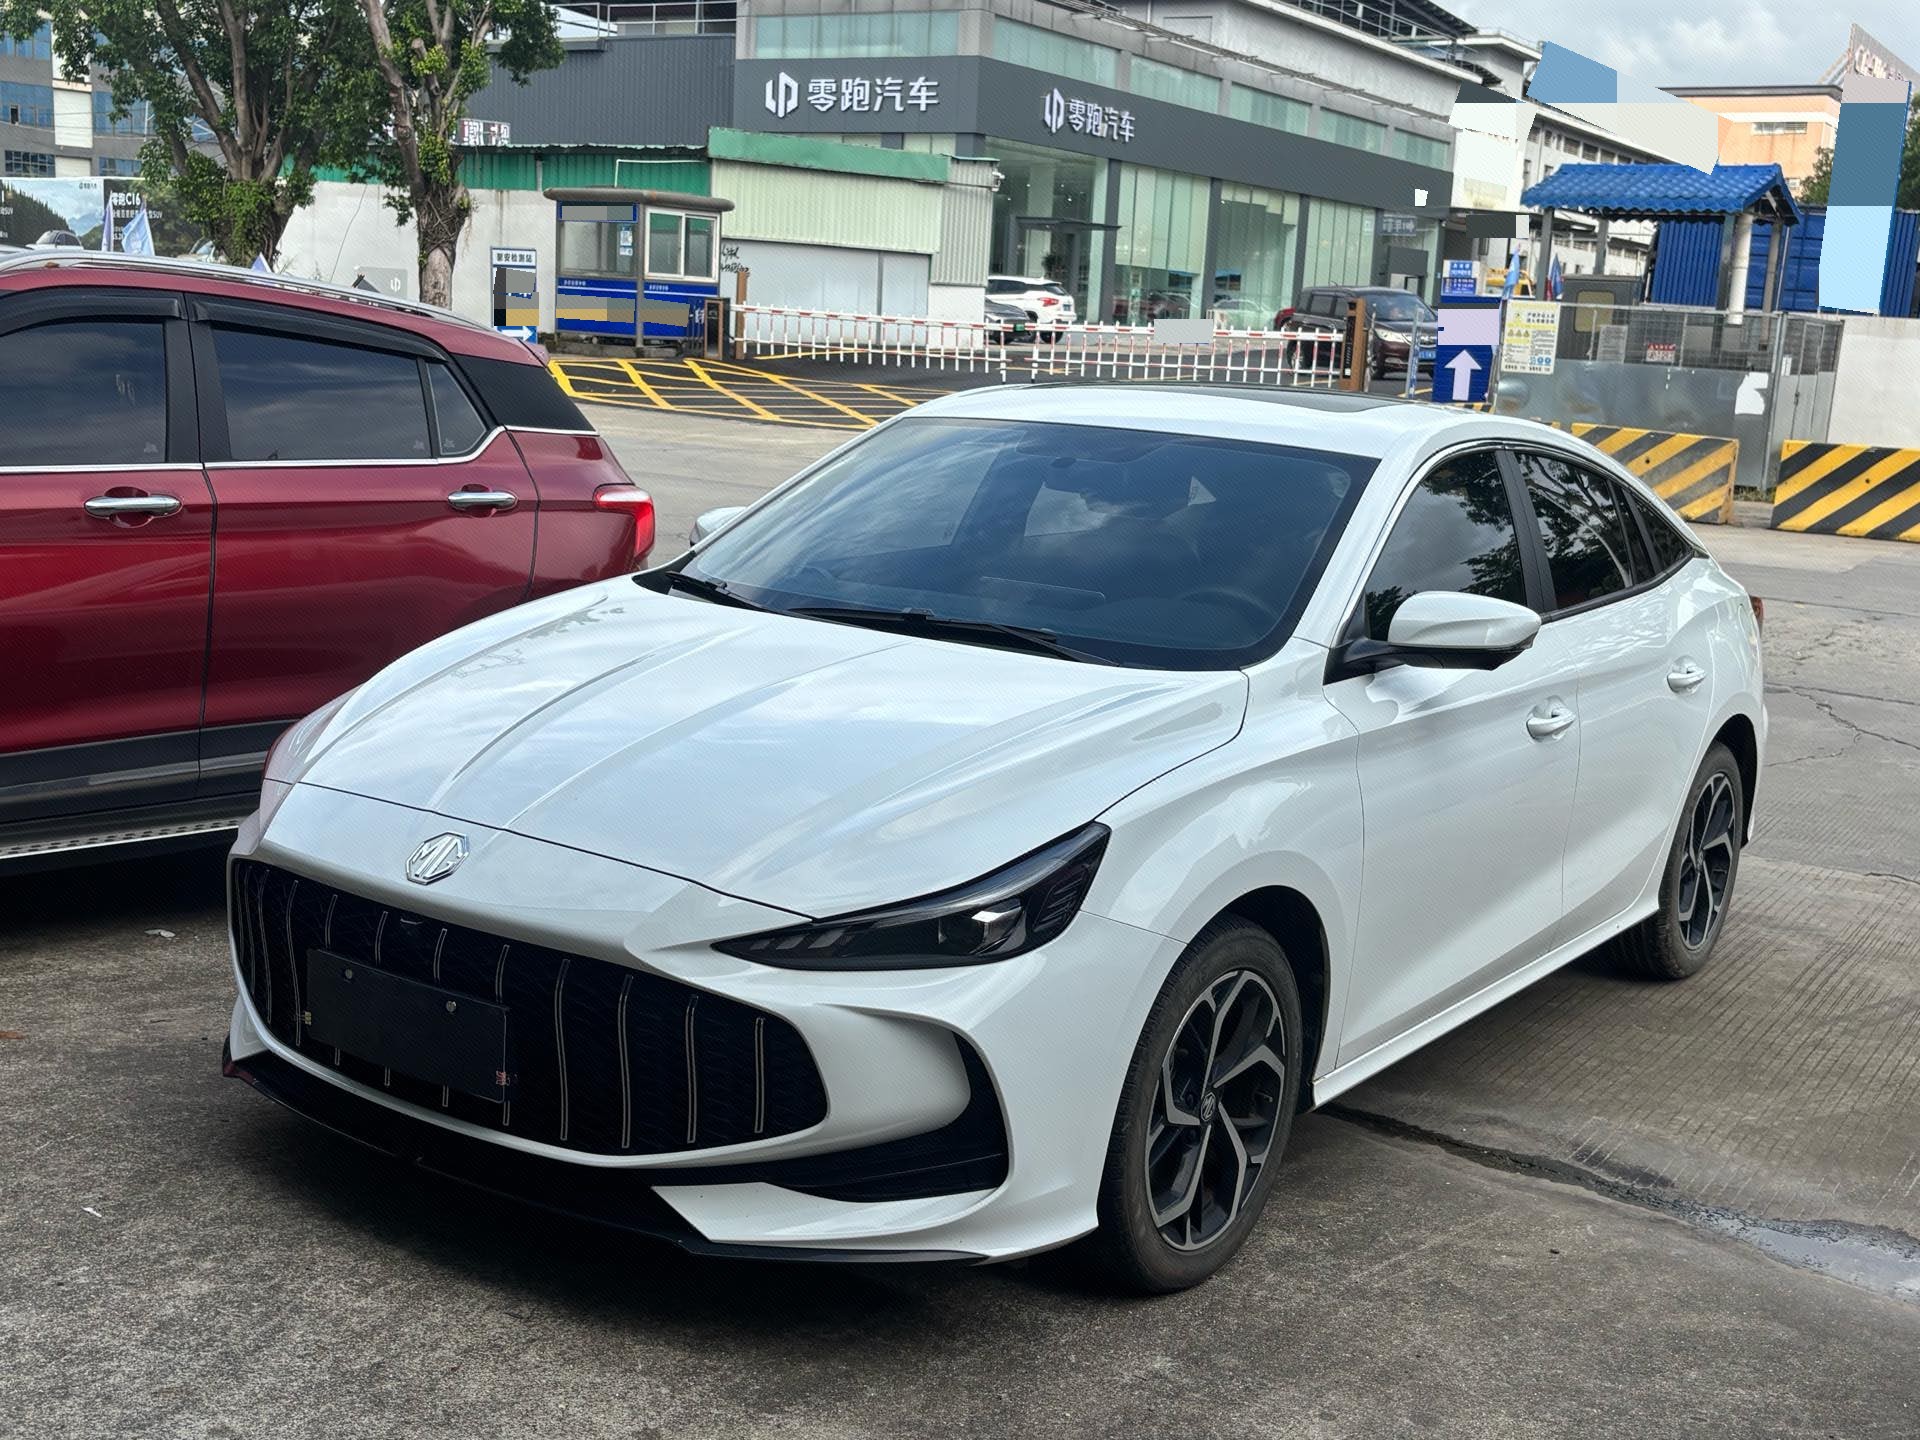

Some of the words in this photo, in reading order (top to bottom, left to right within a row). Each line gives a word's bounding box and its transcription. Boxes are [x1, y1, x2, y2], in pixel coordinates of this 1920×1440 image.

[807, 76, 939, 112] 零跑汽车
[1068, 98, 1136, 142] 零跑汽车
[410, 834, 465, 881] MG
